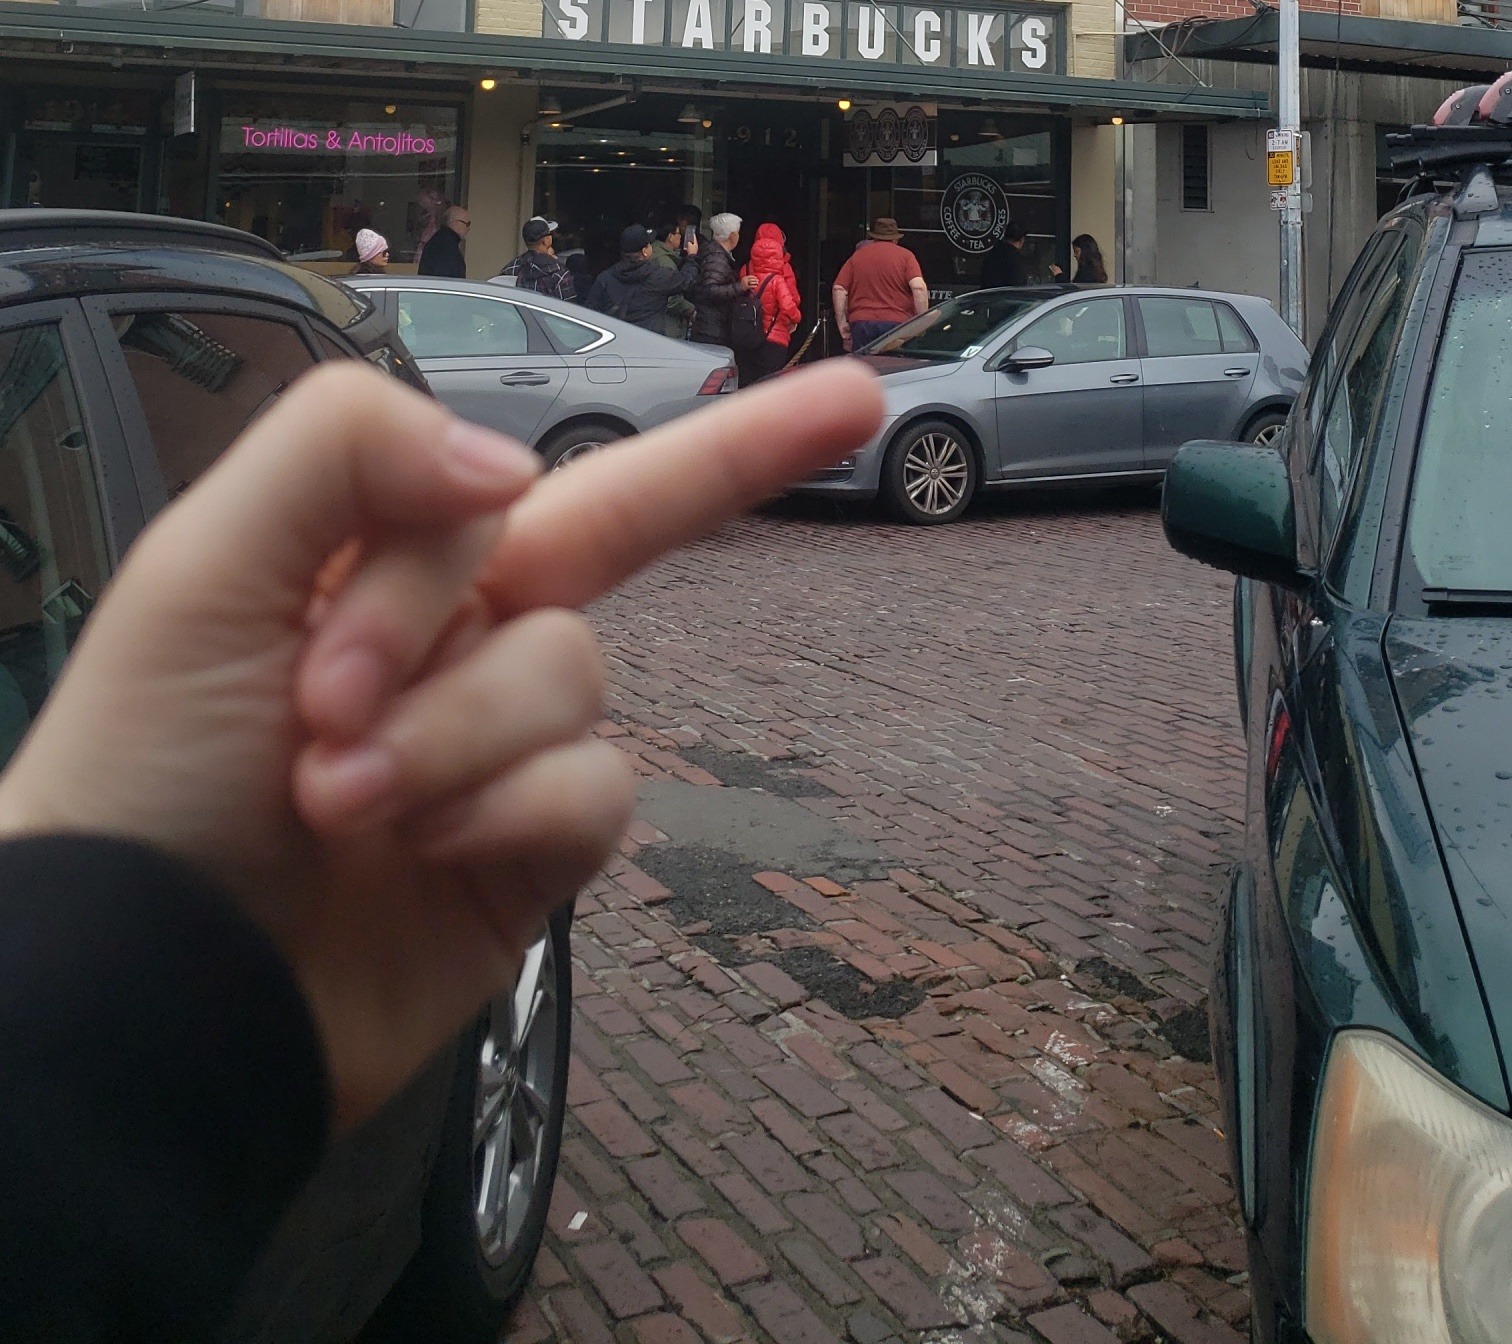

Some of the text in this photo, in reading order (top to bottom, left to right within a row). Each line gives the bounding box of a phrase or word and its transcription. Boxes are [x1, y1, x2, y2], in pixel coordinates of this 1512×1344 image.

[241, 126, 436, 155] Tortillas & Antojitos
[953, 177, 997, 194] STARBUCKS
[944, 206, 961, 240] COFFEE
[992, 208, 1006, 239] SPICES
[969, 239, 985, 249] TEA
